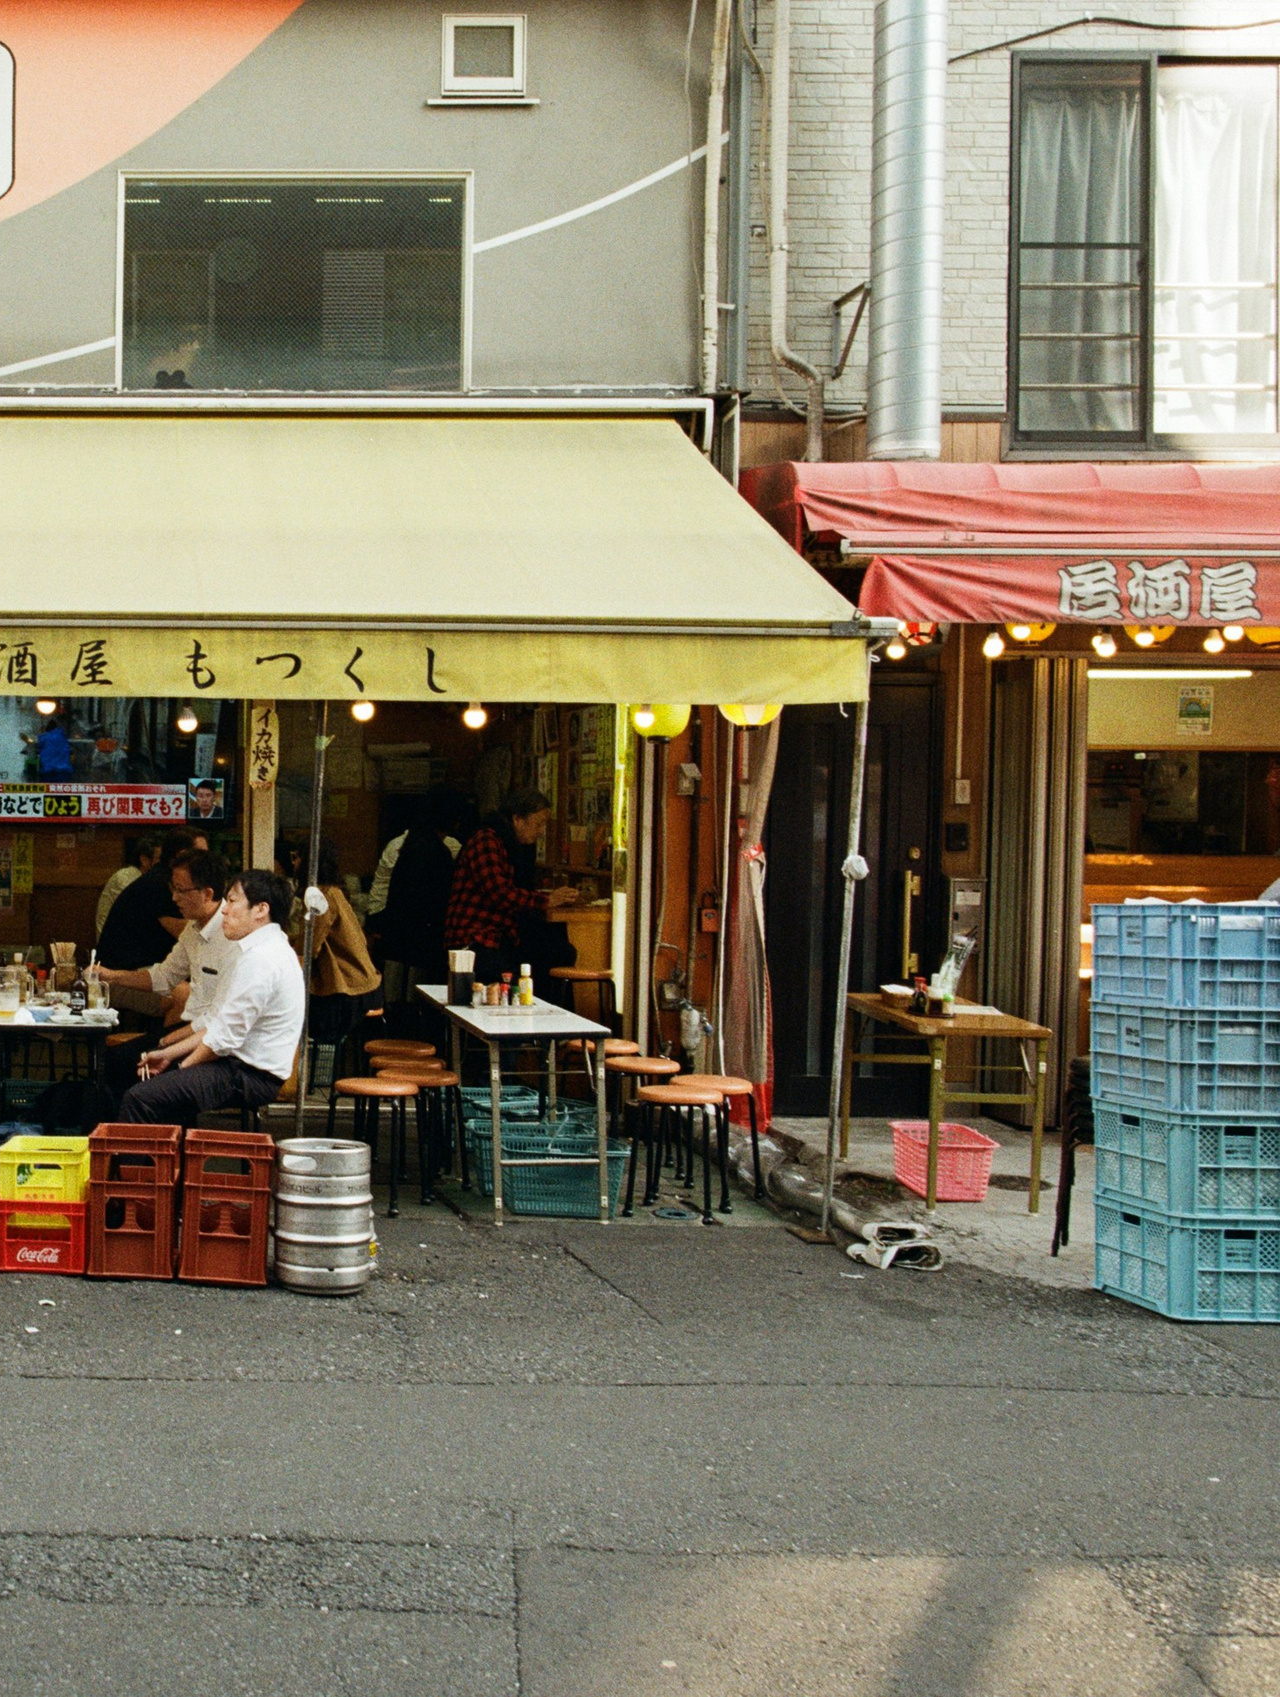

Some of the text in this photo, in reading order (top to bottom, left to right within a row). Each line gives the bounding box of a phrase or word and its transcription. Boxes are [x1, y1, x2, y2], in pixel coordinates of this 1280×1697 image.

[1057, 559, 1263, 621] 居酒屋
[185, 639, 447, 694] もつくし
[252, 708, 276, 781] イカ焼き
[17, 1246, 60, 1263] Coca-Cola
